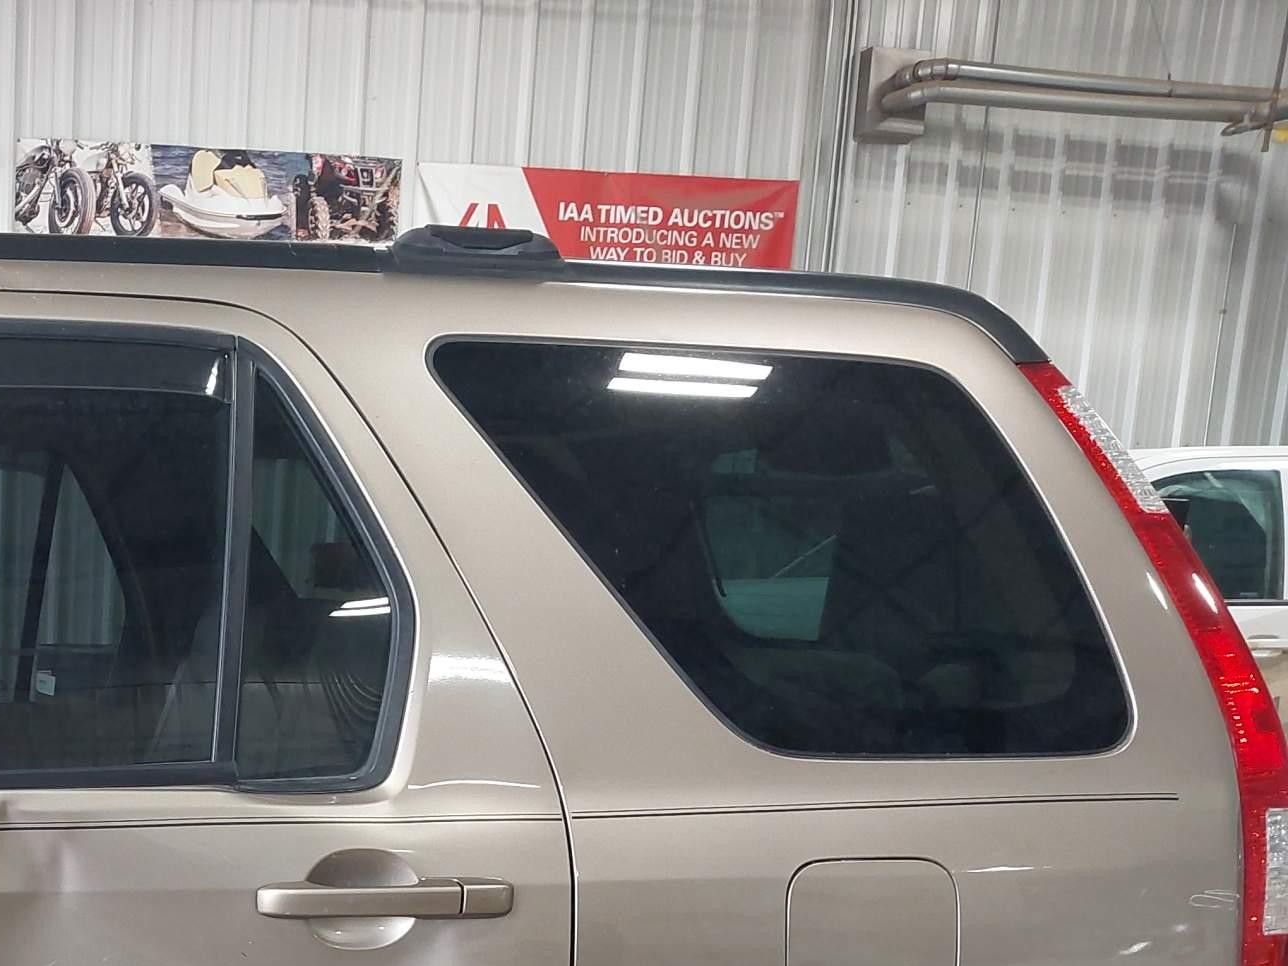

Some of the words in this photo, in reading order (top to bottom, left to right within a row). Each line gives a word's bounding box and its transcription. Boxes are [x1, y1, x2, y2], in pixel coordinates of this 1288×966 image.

[558, 201, 594, 223] IAA
[597, 204, 663, 226] TIMED
[580, 226, 698, 247] INTRODUCING
[702, 231, 717, 247] A
[720, 232, 760, 249] NEW
[589, 246, 629, 261] WAY
[633, 248, 657, 263] TO
[661, 249, 691, 265] BID
[693, 251, 706, 266] &
[711, 252, 748, 267] BUY
